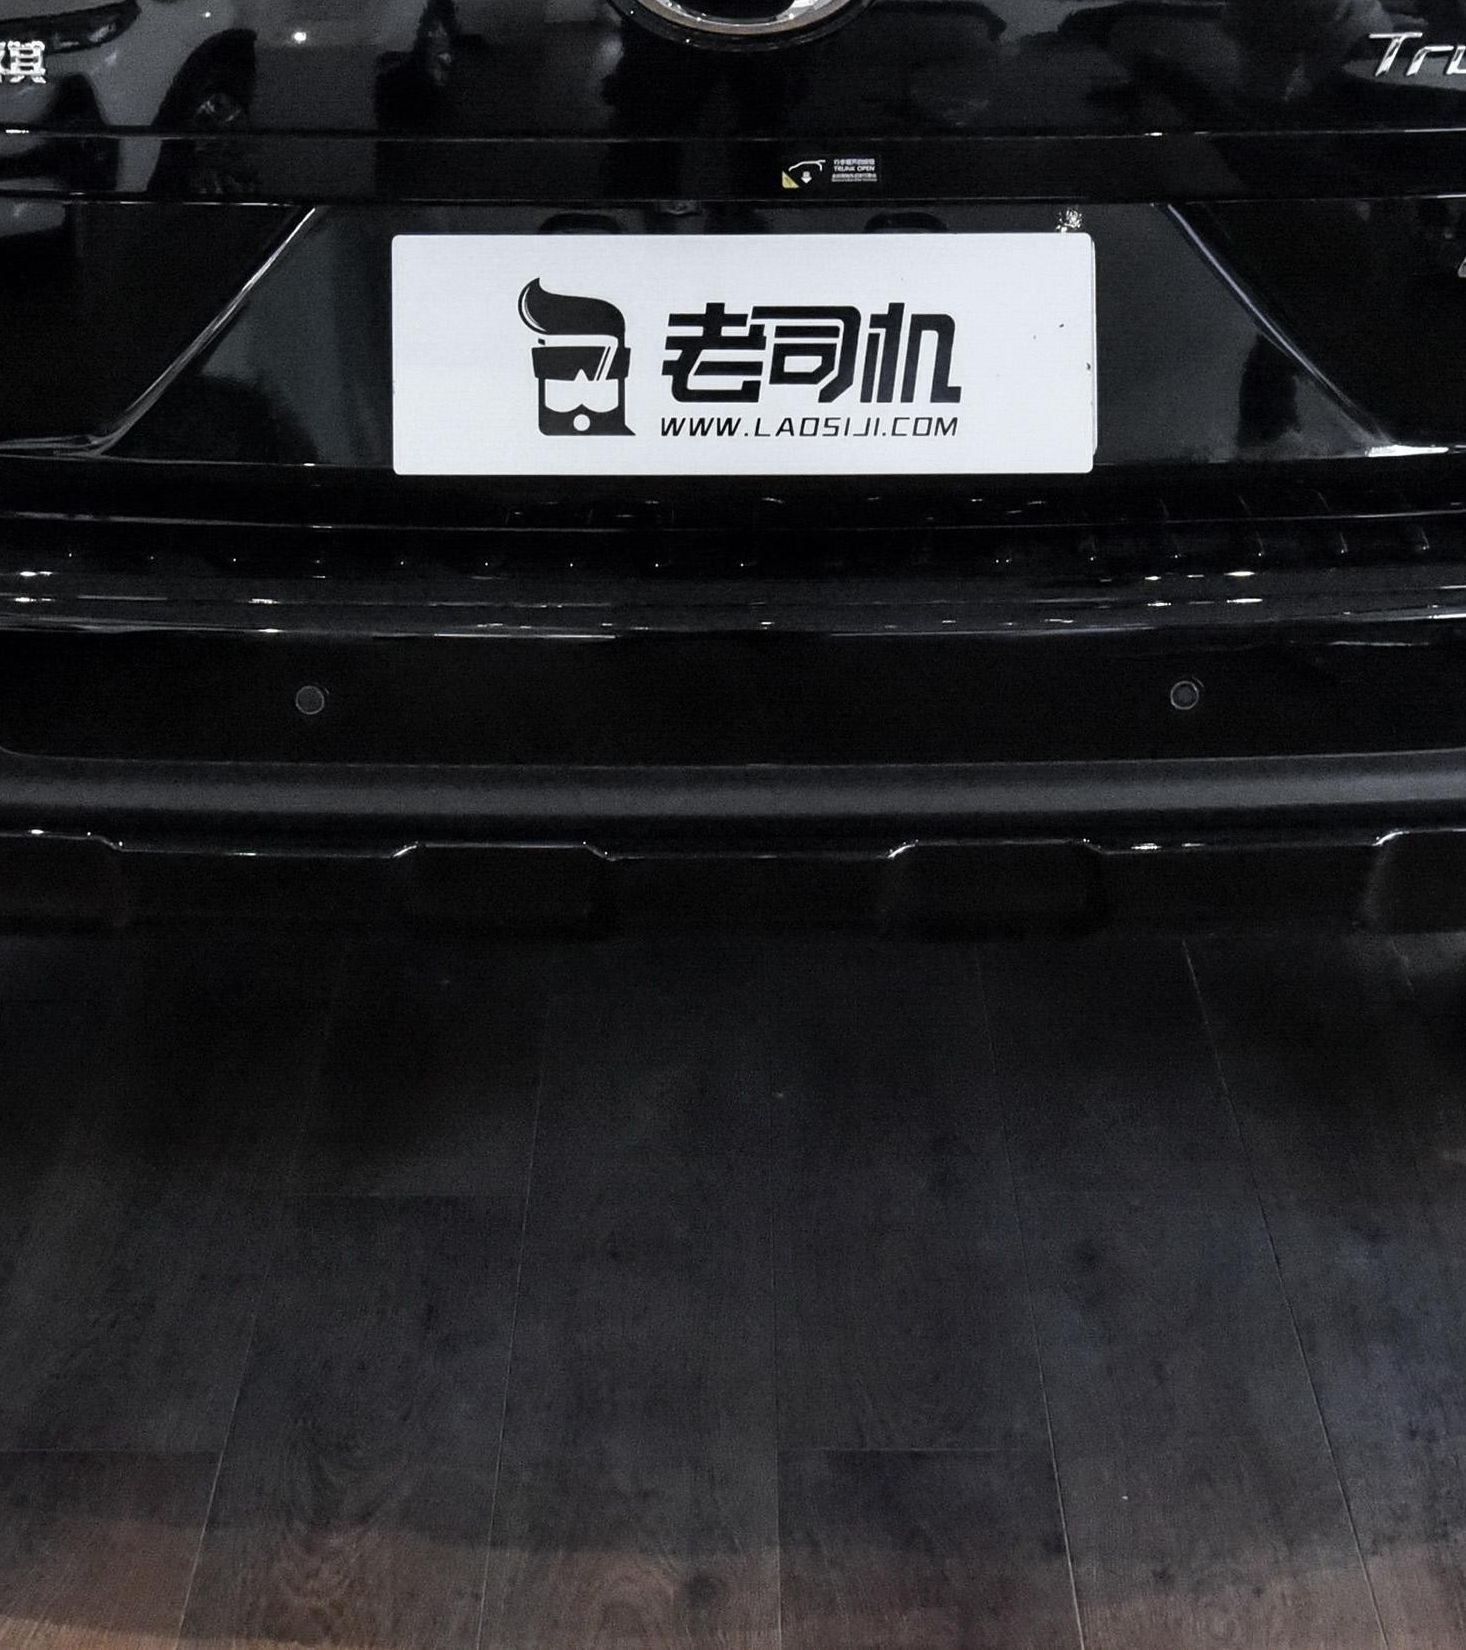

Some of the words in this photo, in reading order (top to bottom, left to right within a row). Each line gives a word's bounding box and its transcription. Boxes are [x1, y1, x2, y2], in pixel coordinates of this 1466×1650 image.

[661, 302, 961, 403] 老司机
[660, 416, 958, 437] WWW.LAOSIJI.COM
